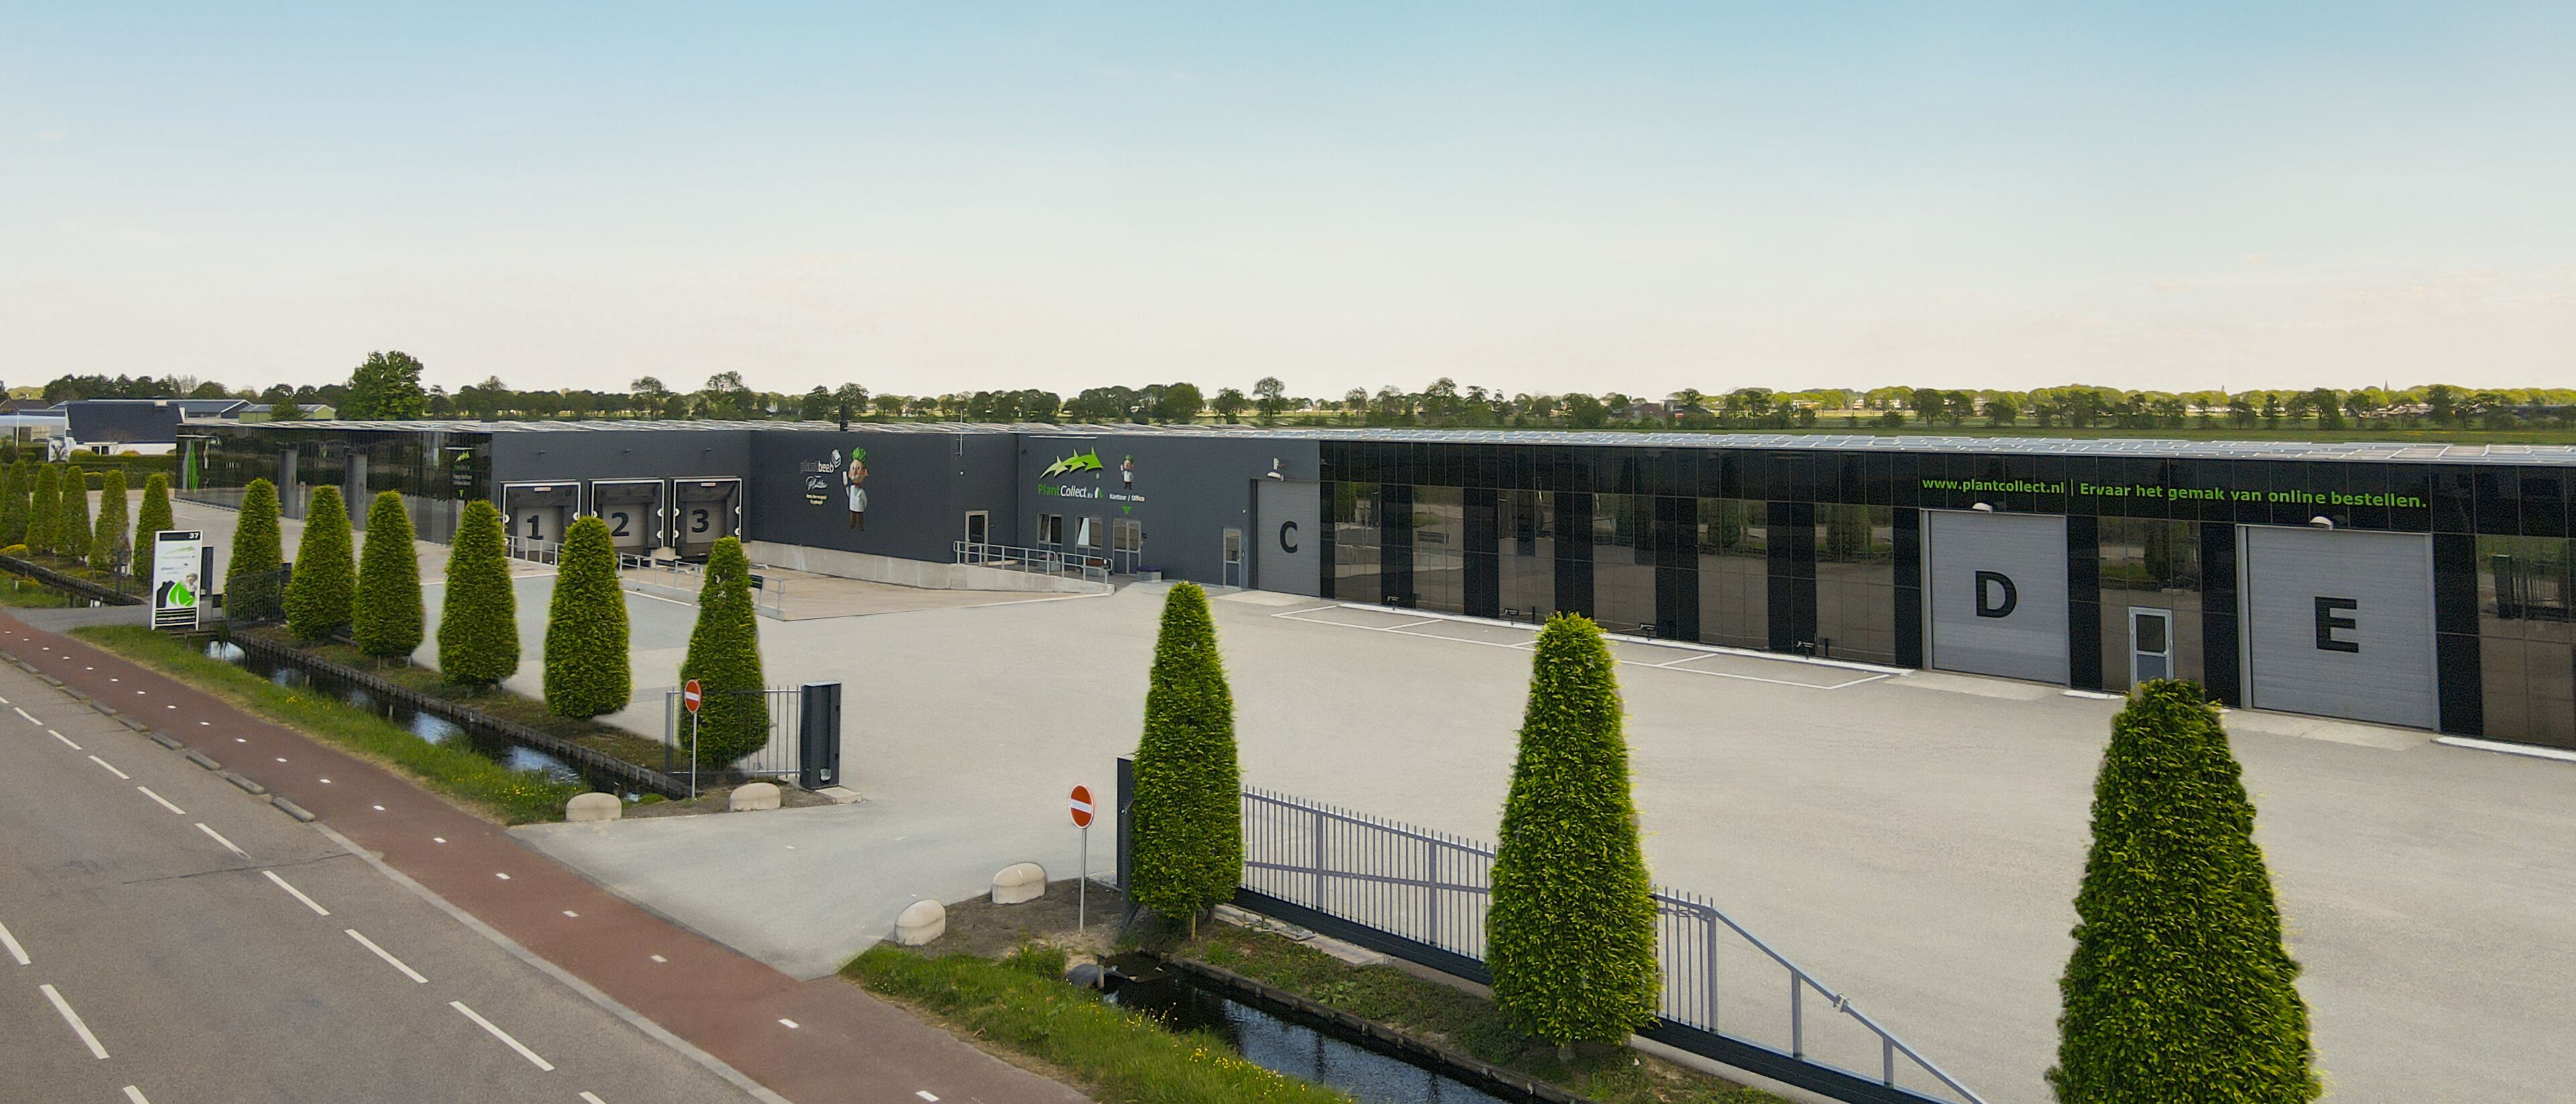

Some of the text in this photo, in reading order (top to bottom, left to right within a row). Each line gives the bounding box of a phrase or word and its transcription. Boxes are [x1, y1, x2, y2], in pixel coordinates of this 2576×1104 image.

[1038, 484, 1087, 498] PlantCollect
[1923, 479, 2065, 494] www.plantcollect.nl
[2080, 482, 2131, 496] Ervaar
[2137, 484, 2163, 498] het
[2168, 487, 2225, 502] gemak
[2231, 489, 2262, 502] van
[2268, 490, 2326, 504] online
[2331, 491, 2427, 508] bestellen.
[527, 515, 543, 540] 1
[611, 512, 629, 537] 2
[692, 509, 709, 533] 3
[1280, 520, 1298, 553] C
[1975, 570, 2017, 618] D
[2314, 596, 2359, 653] E
